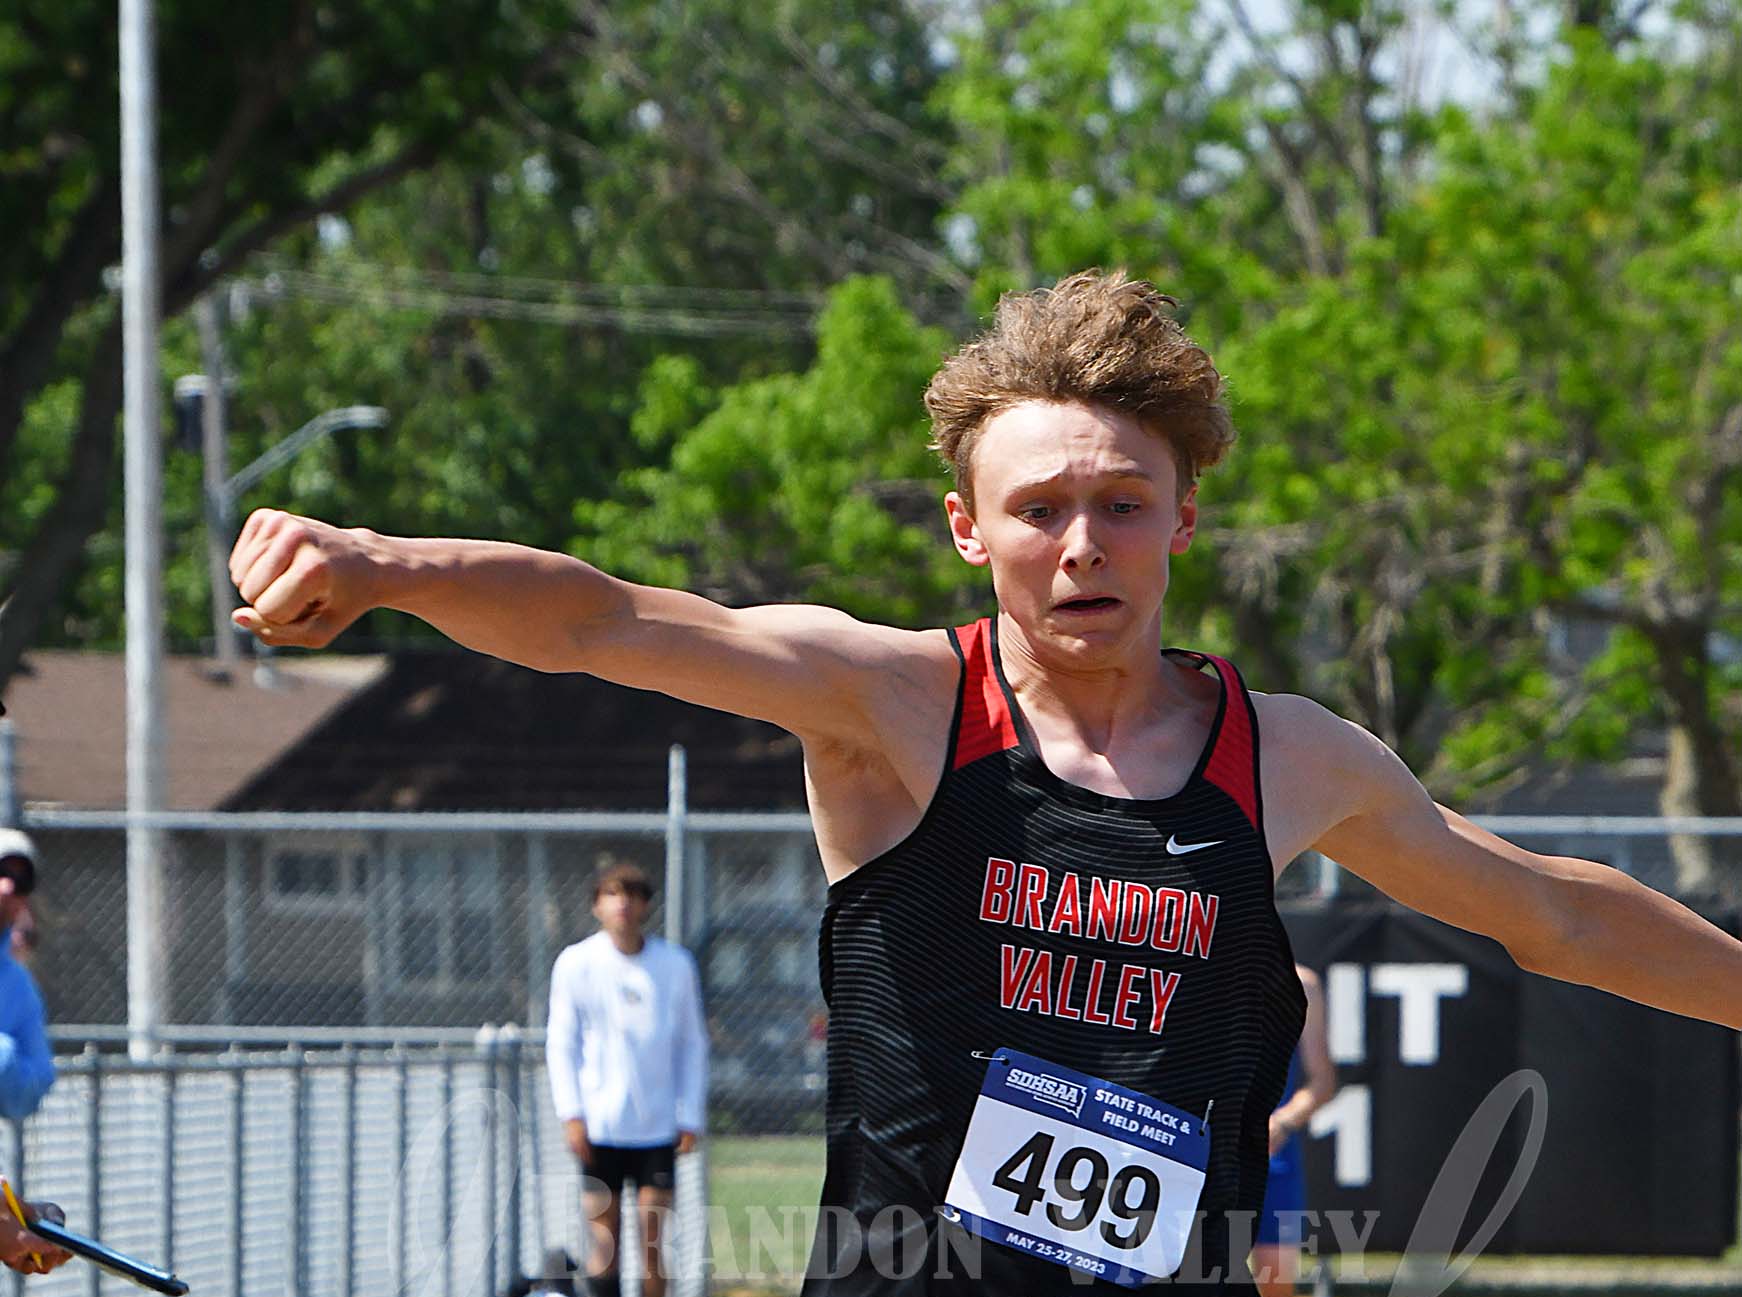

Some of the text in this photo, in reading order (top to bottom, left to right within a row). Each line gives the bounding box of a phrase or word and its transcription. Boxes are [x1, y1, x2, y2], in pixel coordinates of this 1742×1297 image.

[979, 857, 1219, 960] BRANDON
[1000, 944, 1181, 1035] VALLEY
[1006, 1068, 1079, 1103] SDHSAA
[1095, 1088, 1135, 1113] STATE
[1137, 1101, 1178, 1130] TRACK
[1180, 1121, 1191, 1135] &
[1102, 1111, 1177, 1146] FIELD MEET
[1308, 1084, 1372, 1186] 1
[992, 1131, 1161, 1250] 499
[1006, 1231, 1106, 1275] MAY 25-27, 2023
